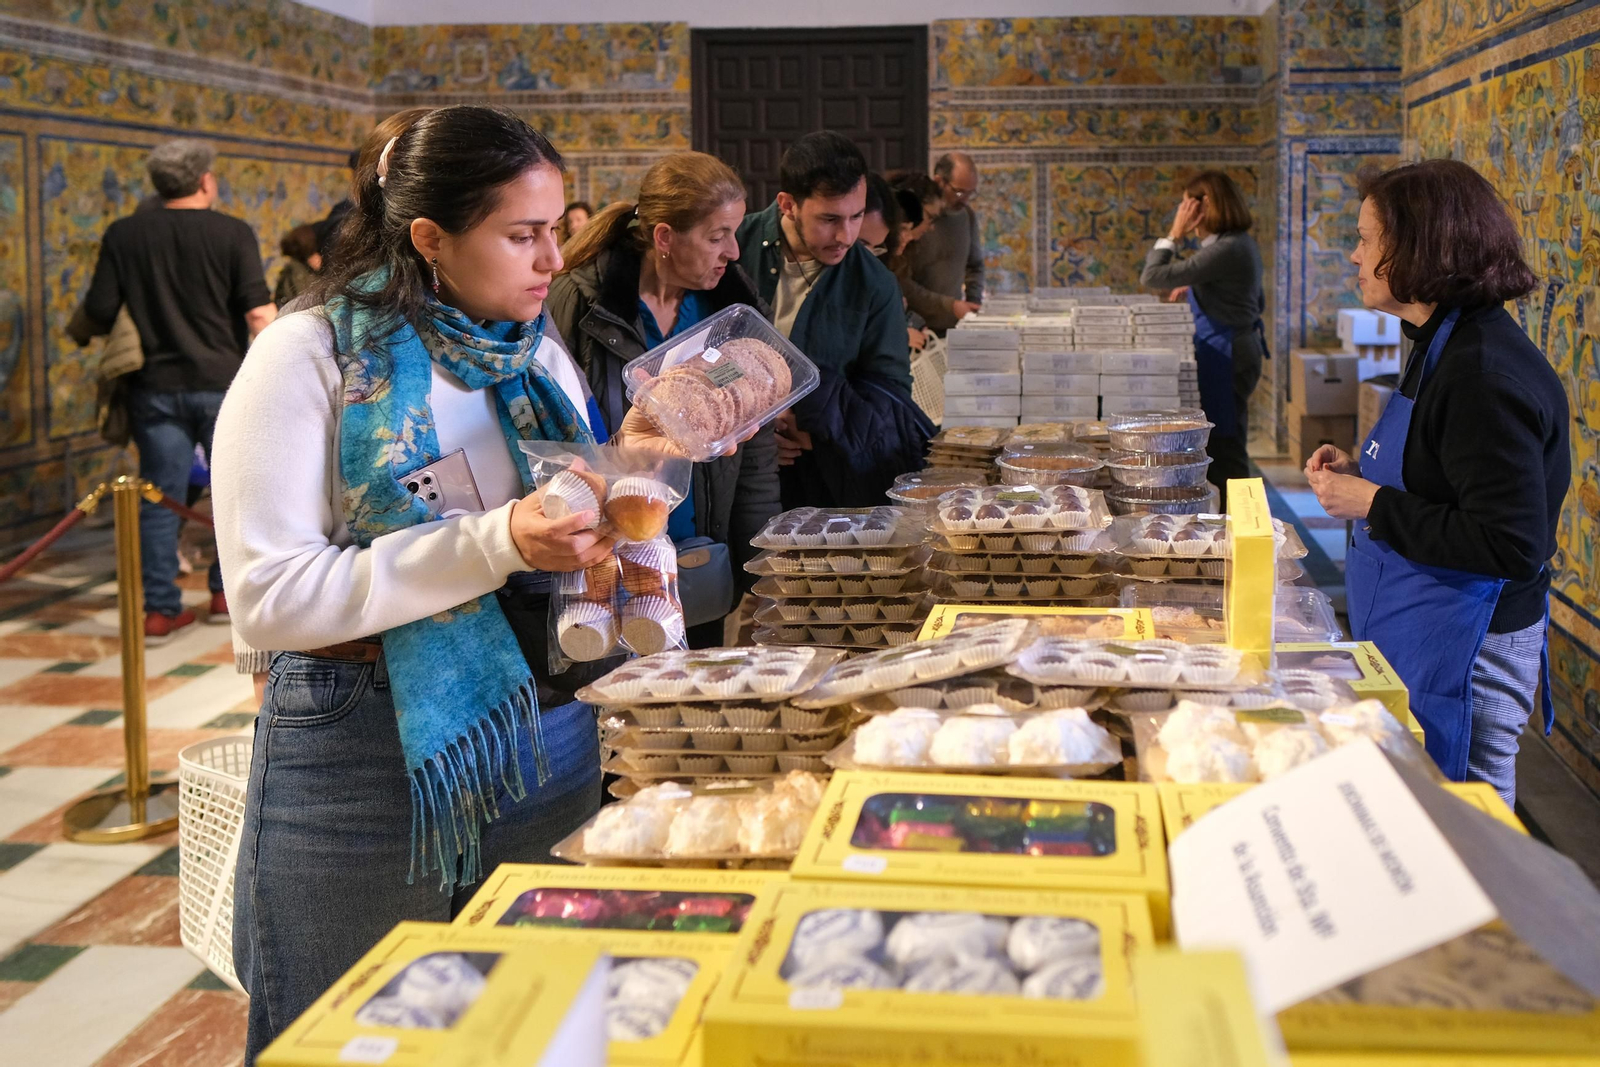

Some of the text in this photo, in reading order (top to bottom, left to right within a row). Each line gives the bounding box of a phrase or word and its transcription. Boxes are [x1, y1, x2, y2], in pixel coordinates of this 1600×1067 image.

[1232, 841, 1249, 859] de
[1262, 804, 1296, 863] Convento
[1287, 863, 1307, 883] de
[1239, 857, 1255, 873] la
